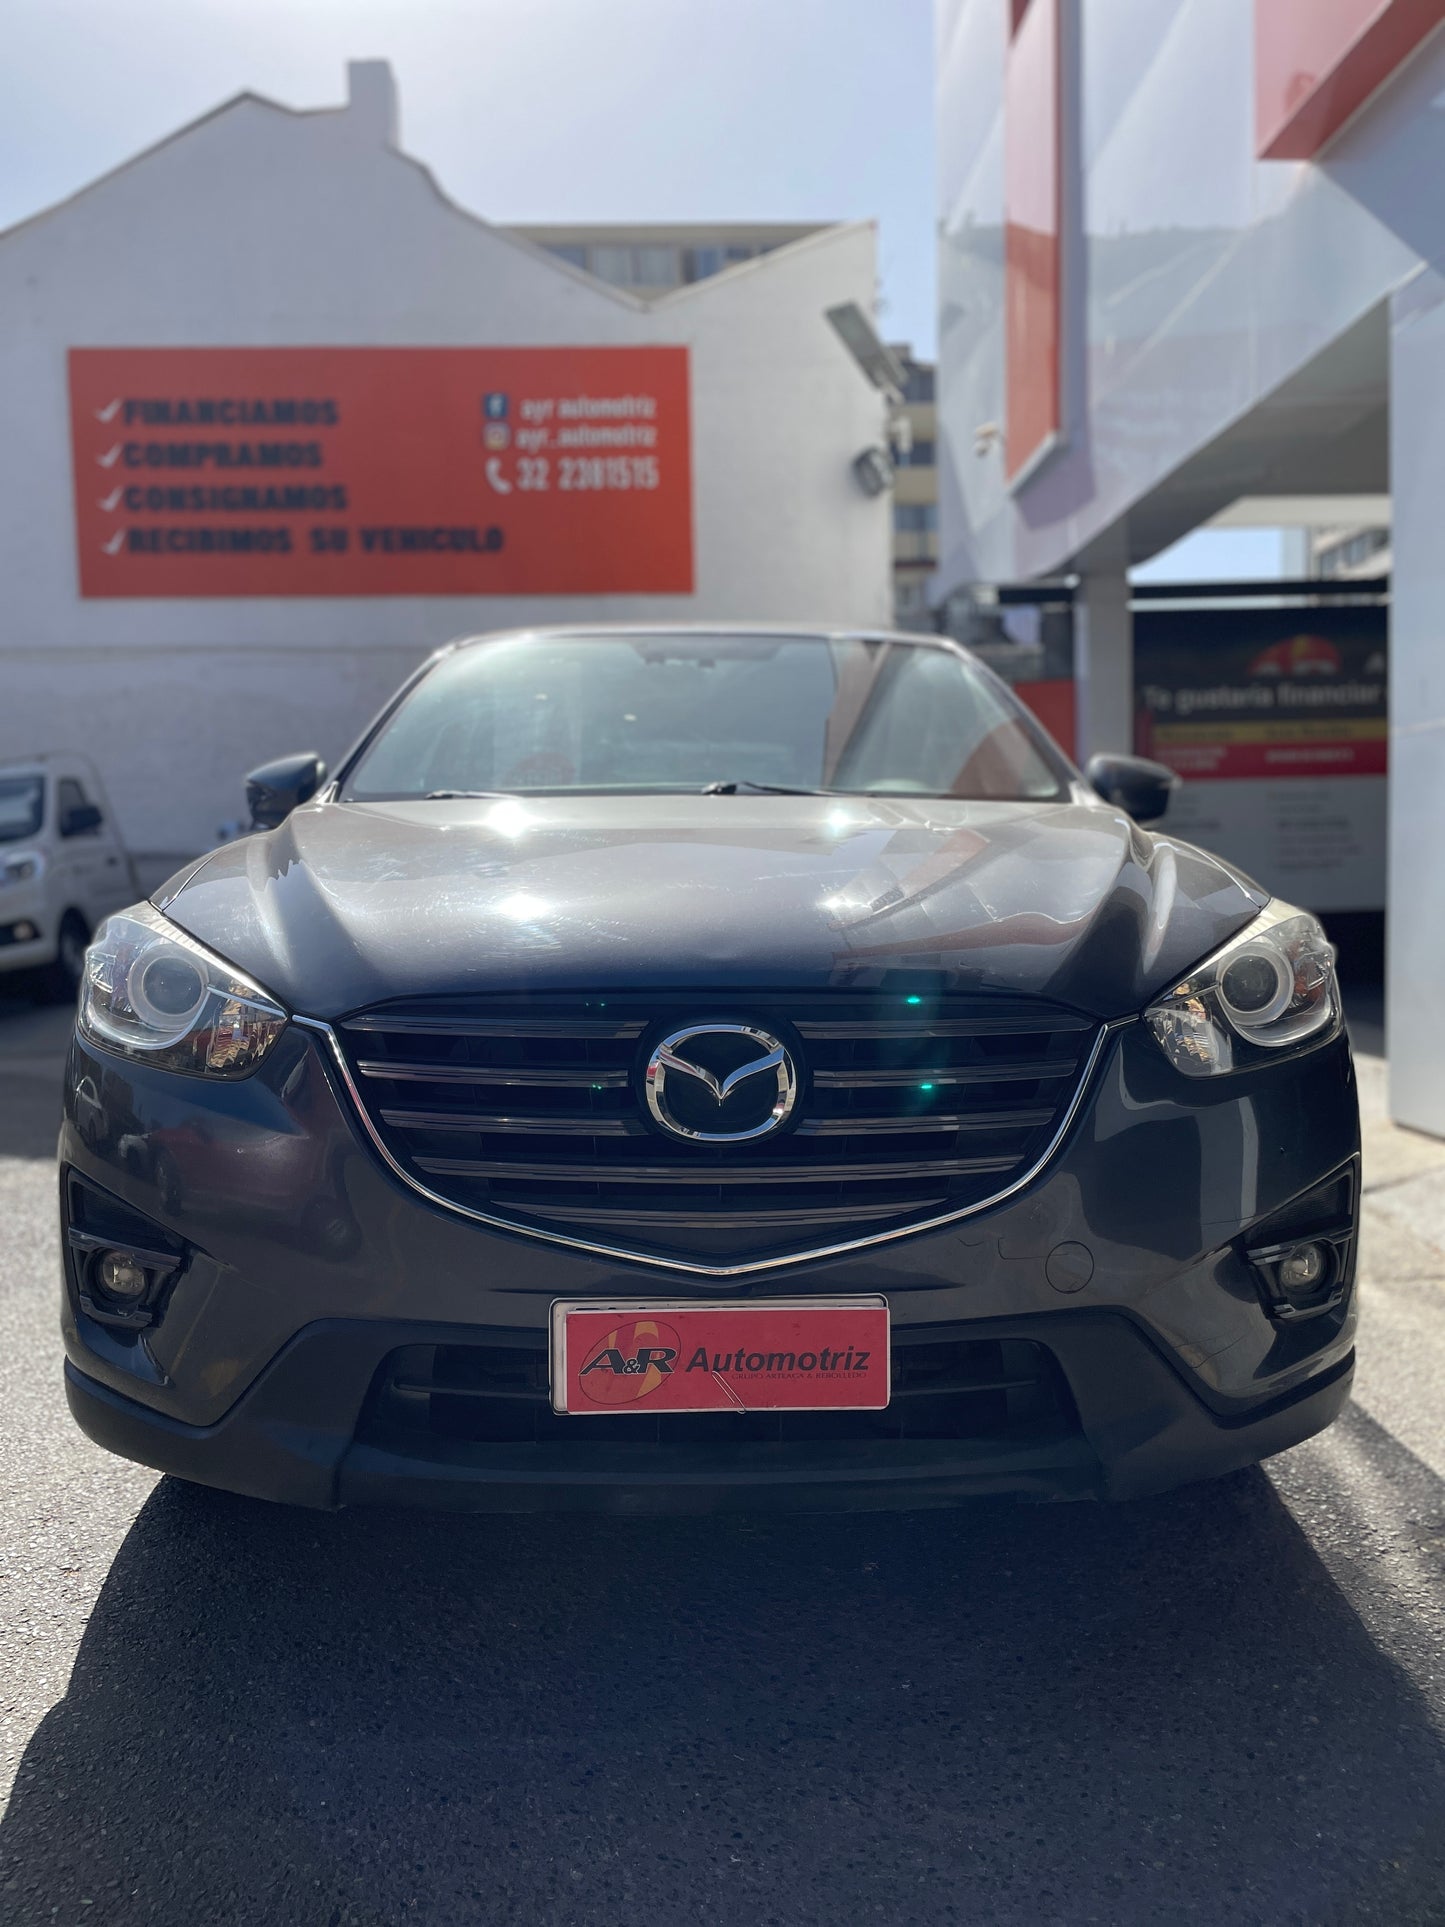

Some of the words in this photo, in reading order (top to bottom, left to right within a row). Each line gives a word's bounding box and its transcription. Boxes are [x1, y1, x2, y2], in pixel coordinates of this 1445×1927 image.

[124, 398, 338, 426] FINANCIAMOS
[520, 399, 554, 424] ayr
[558, 396, 656, 419] automotriz
[124, 442, 321, 468] COMPRAMOS
[517, 457, 548, 489] 32
[125, 485, 347, 512] CONSIGNAMOS
[127, 527, 292, 554] RECIBIMOS
[310, 527, 348, 553] SU
[360, 527, 504, 553] VEHICULO
[1143, 686, 1170, 709] Te
[1279, 681, 1380, 706] financiar
[578, 1347, 677, 1376] A&R
[685, 1346, 870, 1372] Automotriz
